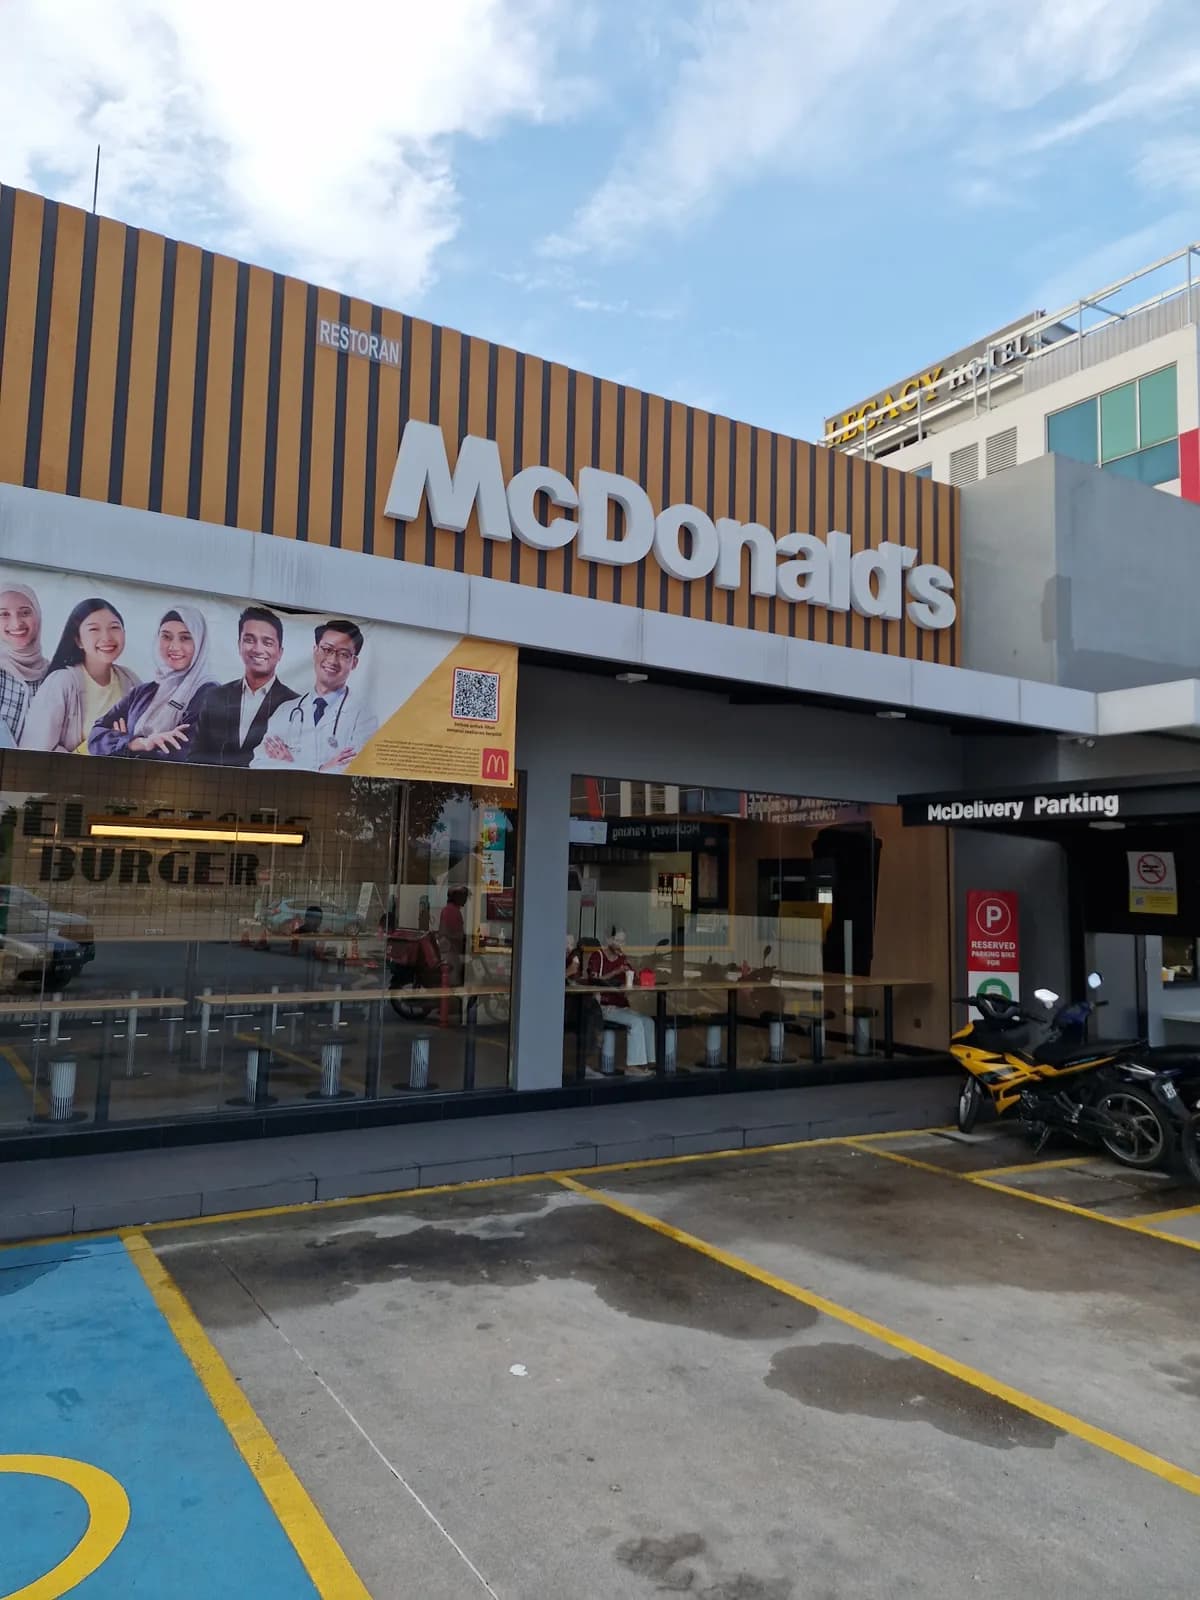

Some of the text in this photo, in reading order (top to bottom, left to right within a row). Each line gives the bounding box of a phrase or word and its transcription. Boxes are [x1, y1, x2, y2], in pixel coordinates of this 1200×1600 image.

[319, 319, 400, 364] RESTORAN
[826, 334, 1031, 447] LEGACY HOTEL
[383, 418, 957, 631] McDonald's
[927, 792, 1119, 821] McDelivery Parking
[39, 846, 260, 886] BURGER
[986, 905, 1002, 929] P
[971, 940, 1016, 950] RESERVED
[971, 950, 1000, 958] PARKING
